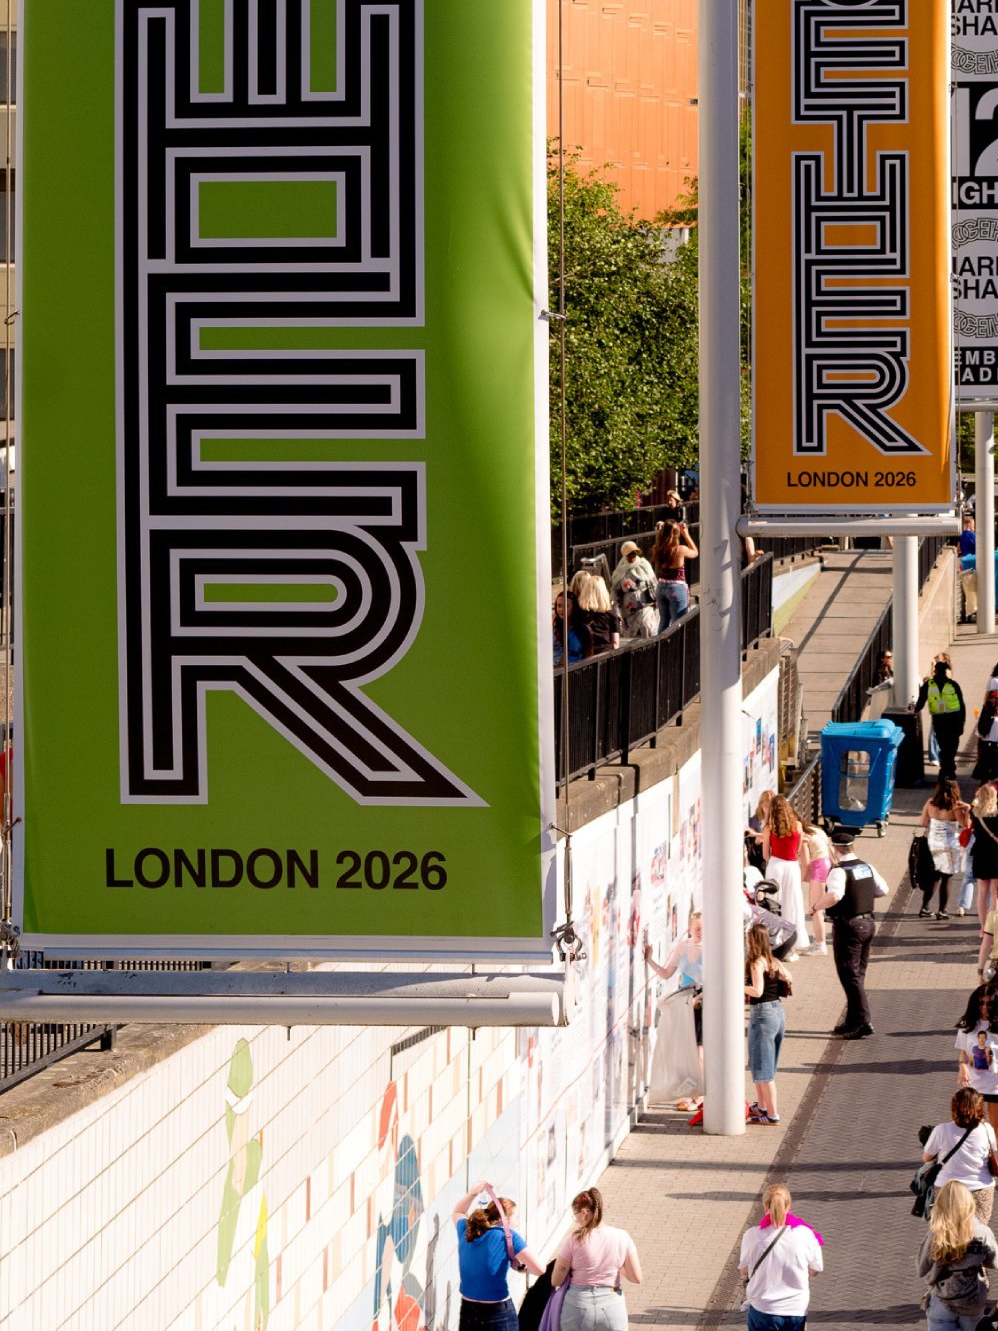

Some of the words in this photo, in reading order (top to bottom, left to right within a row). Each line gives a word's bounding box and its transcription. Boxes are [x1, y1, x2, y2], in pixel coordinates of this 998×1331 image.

[787, 471, 869, 488] LONDON
[874, 471, 916, 487] 2026
[105, 847, 320, 890] LONDON
[335, 850, 448, 891] 2026
